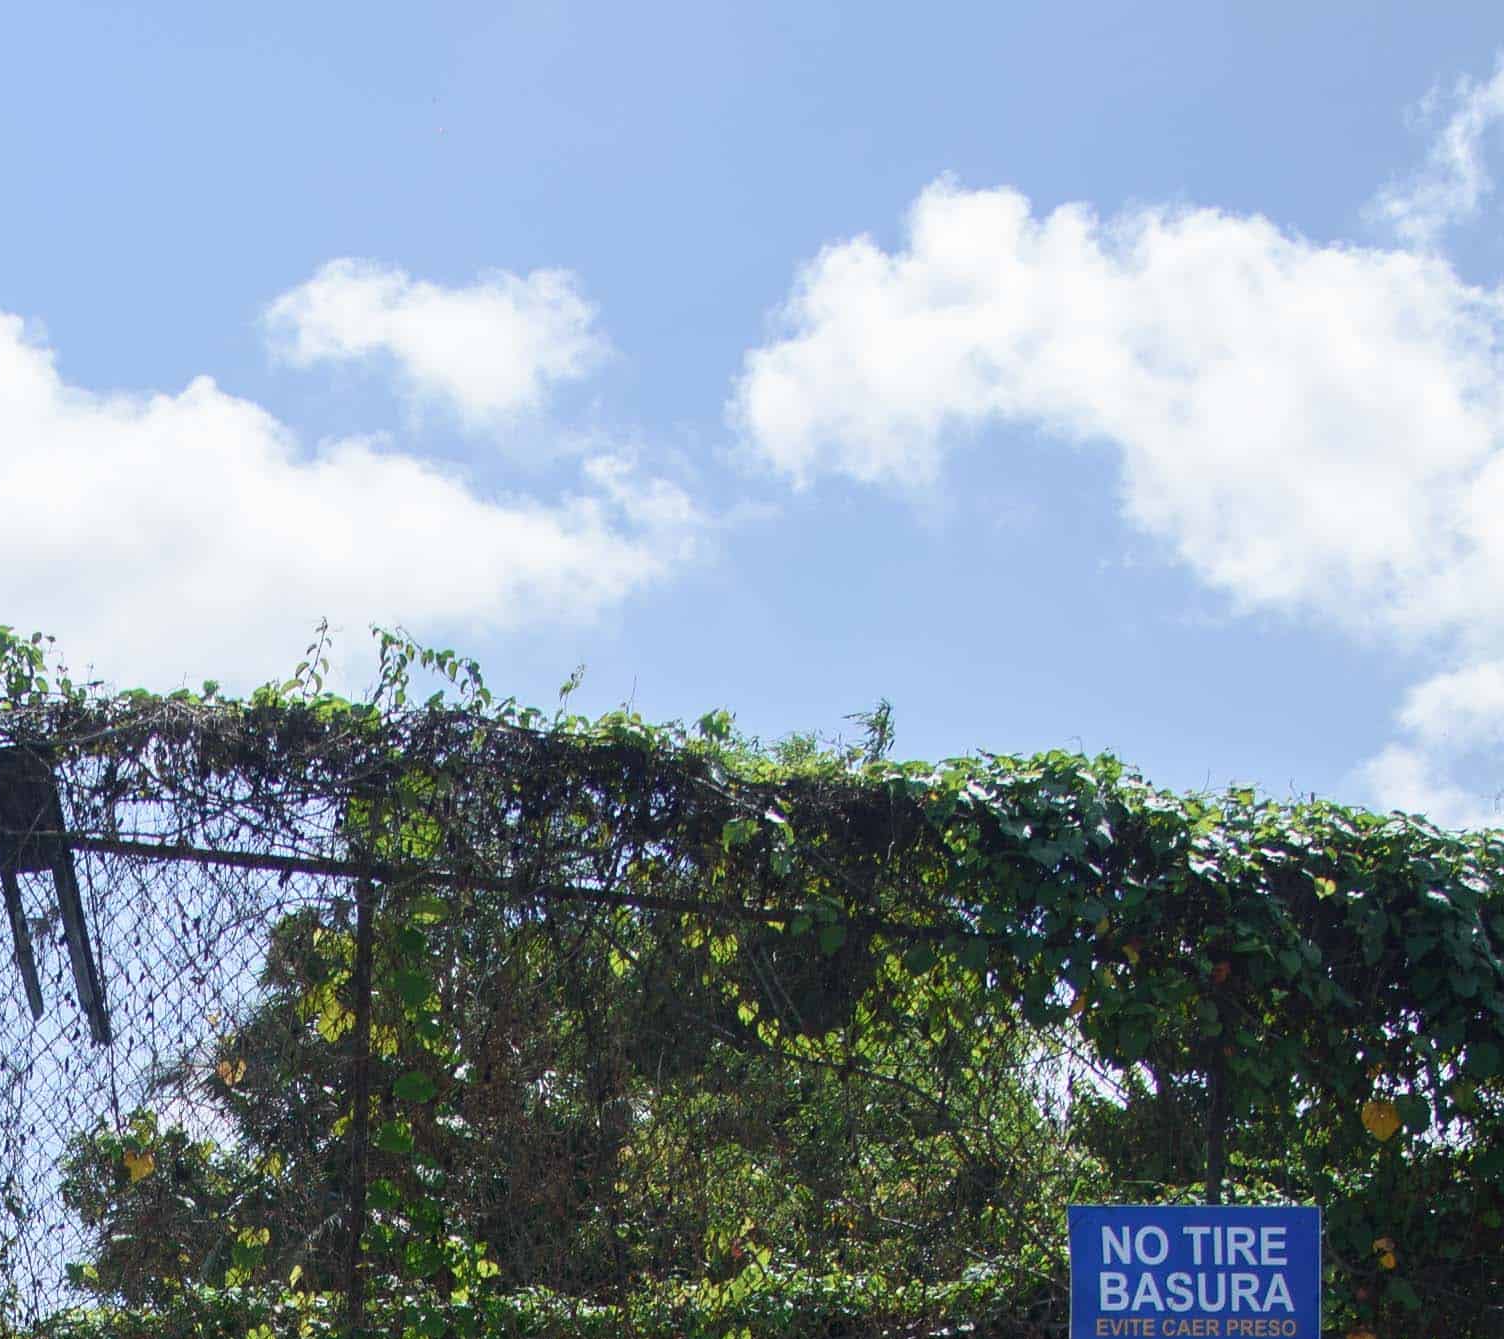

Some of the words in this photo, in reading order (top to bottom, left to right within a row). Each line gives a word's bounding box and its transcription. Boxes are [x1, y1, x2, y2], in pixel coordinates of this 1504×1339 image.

[1101, 1225, 1169, 1266] NO
[1182, 1226, 1288, 1266] TIRE
[1099, 1271, 1296, 1312] BASURA
[1095, 1318, 1156, 1337] EVITE
[1162, 1318, 1220, 1337] CAER
[1226, 1319, 1297, 1337] PRESO
